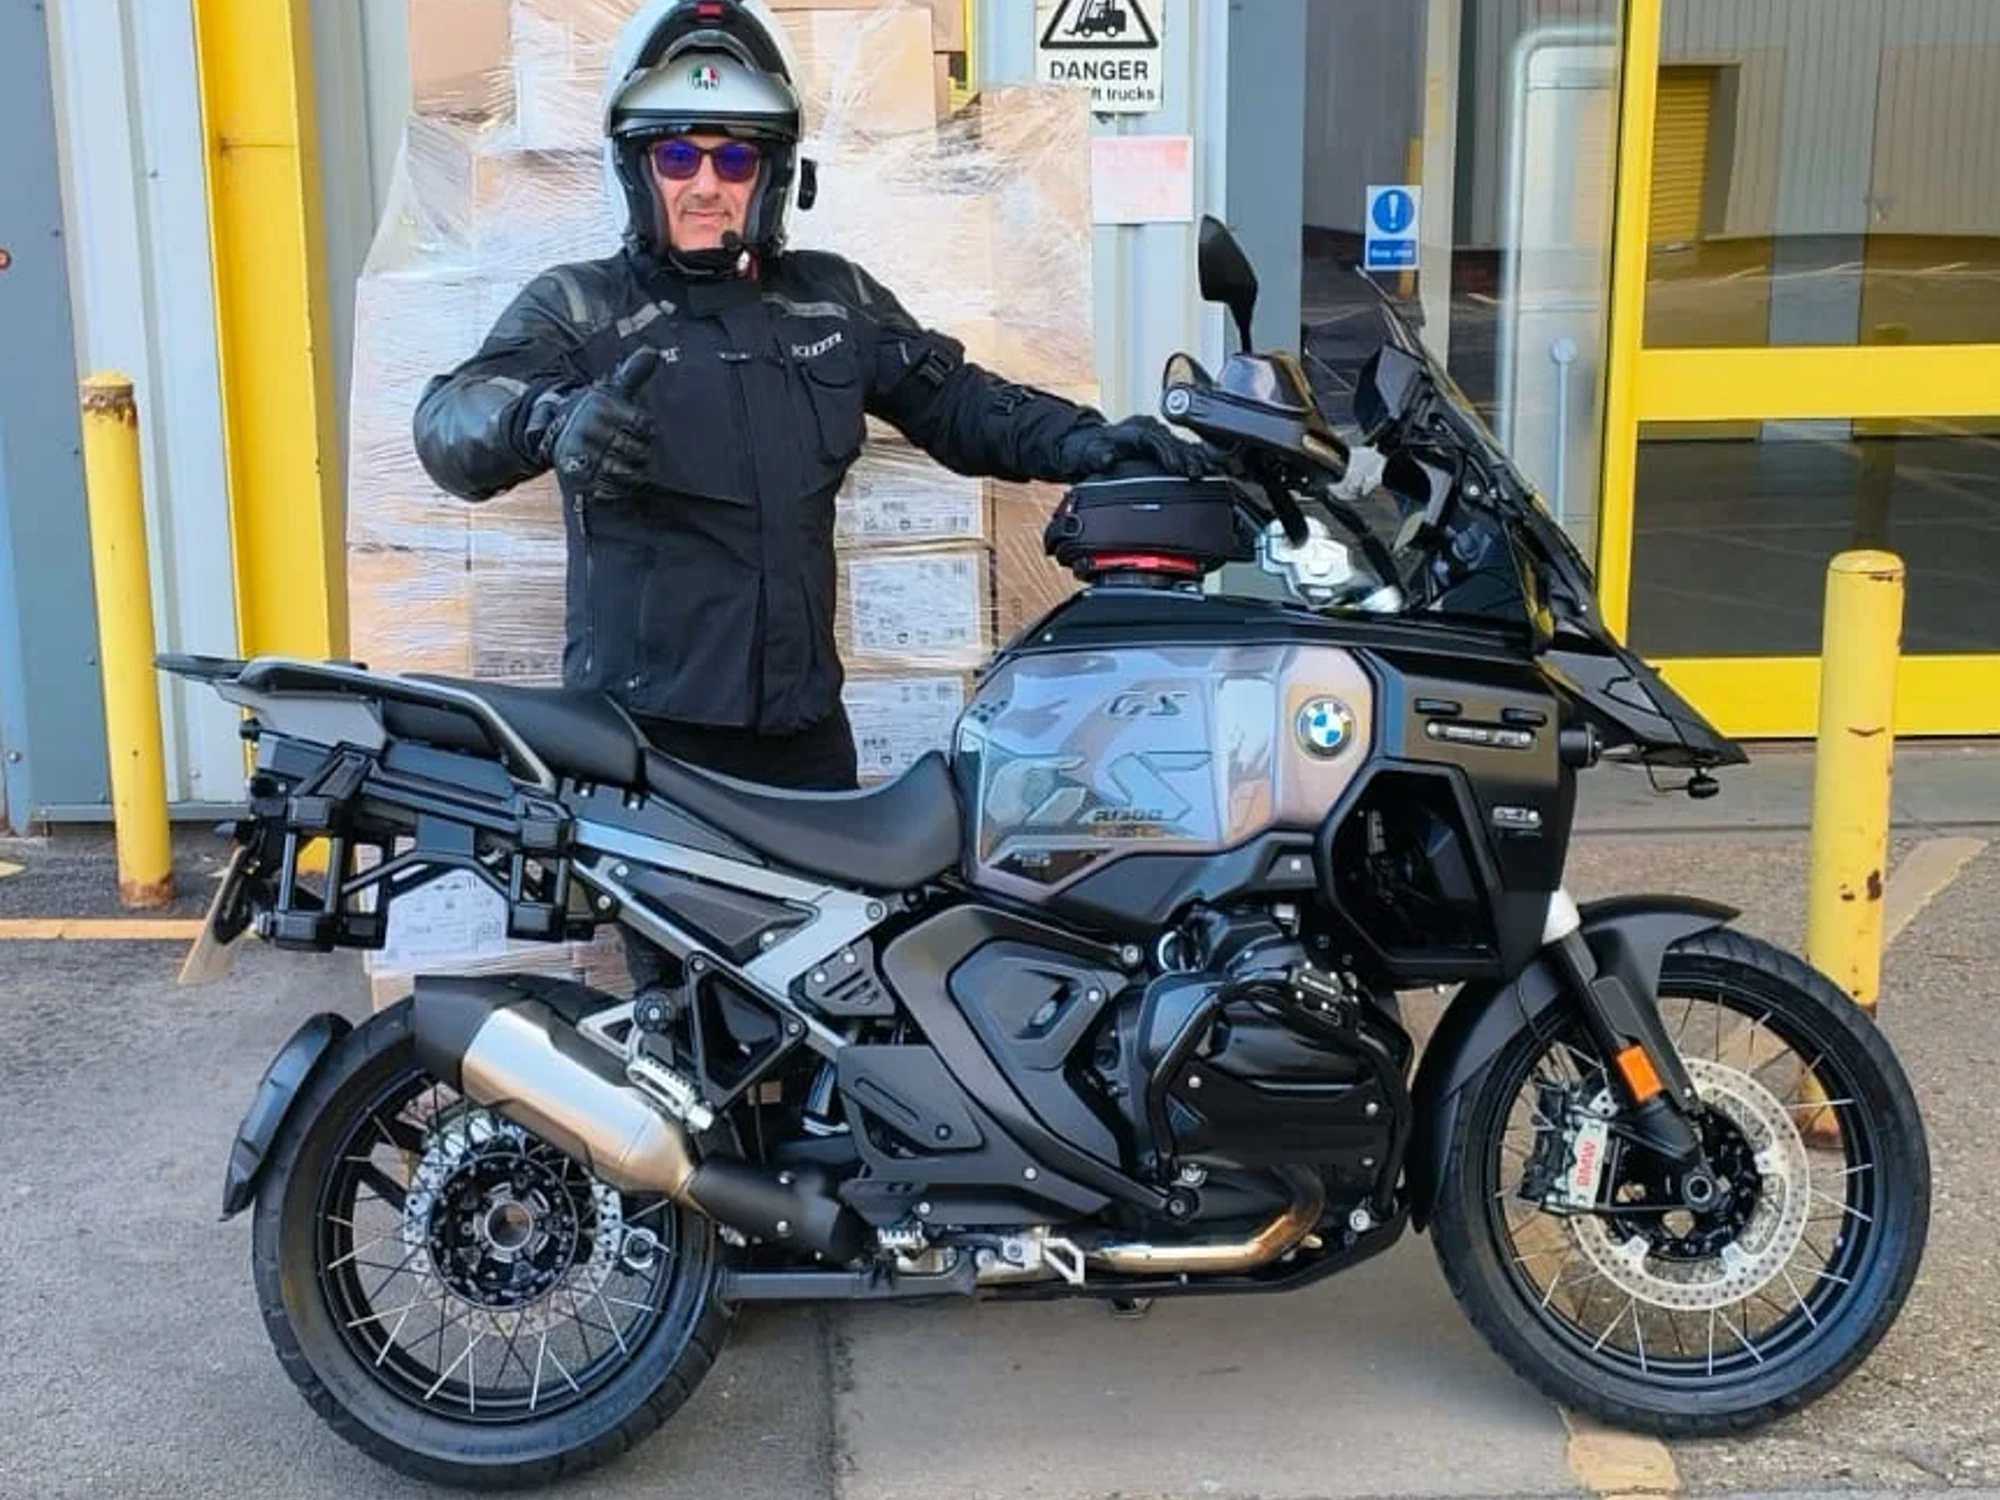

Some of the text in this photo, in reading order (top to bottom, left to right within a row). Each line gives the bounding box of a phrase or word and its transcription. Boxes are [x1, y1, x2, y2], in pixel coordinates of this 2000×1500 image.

[1050, 60, 1148, 80] DANGER
[1107, 86, 1154, 101] trucks
[1576, 1140, 1597, 1187] BMW
